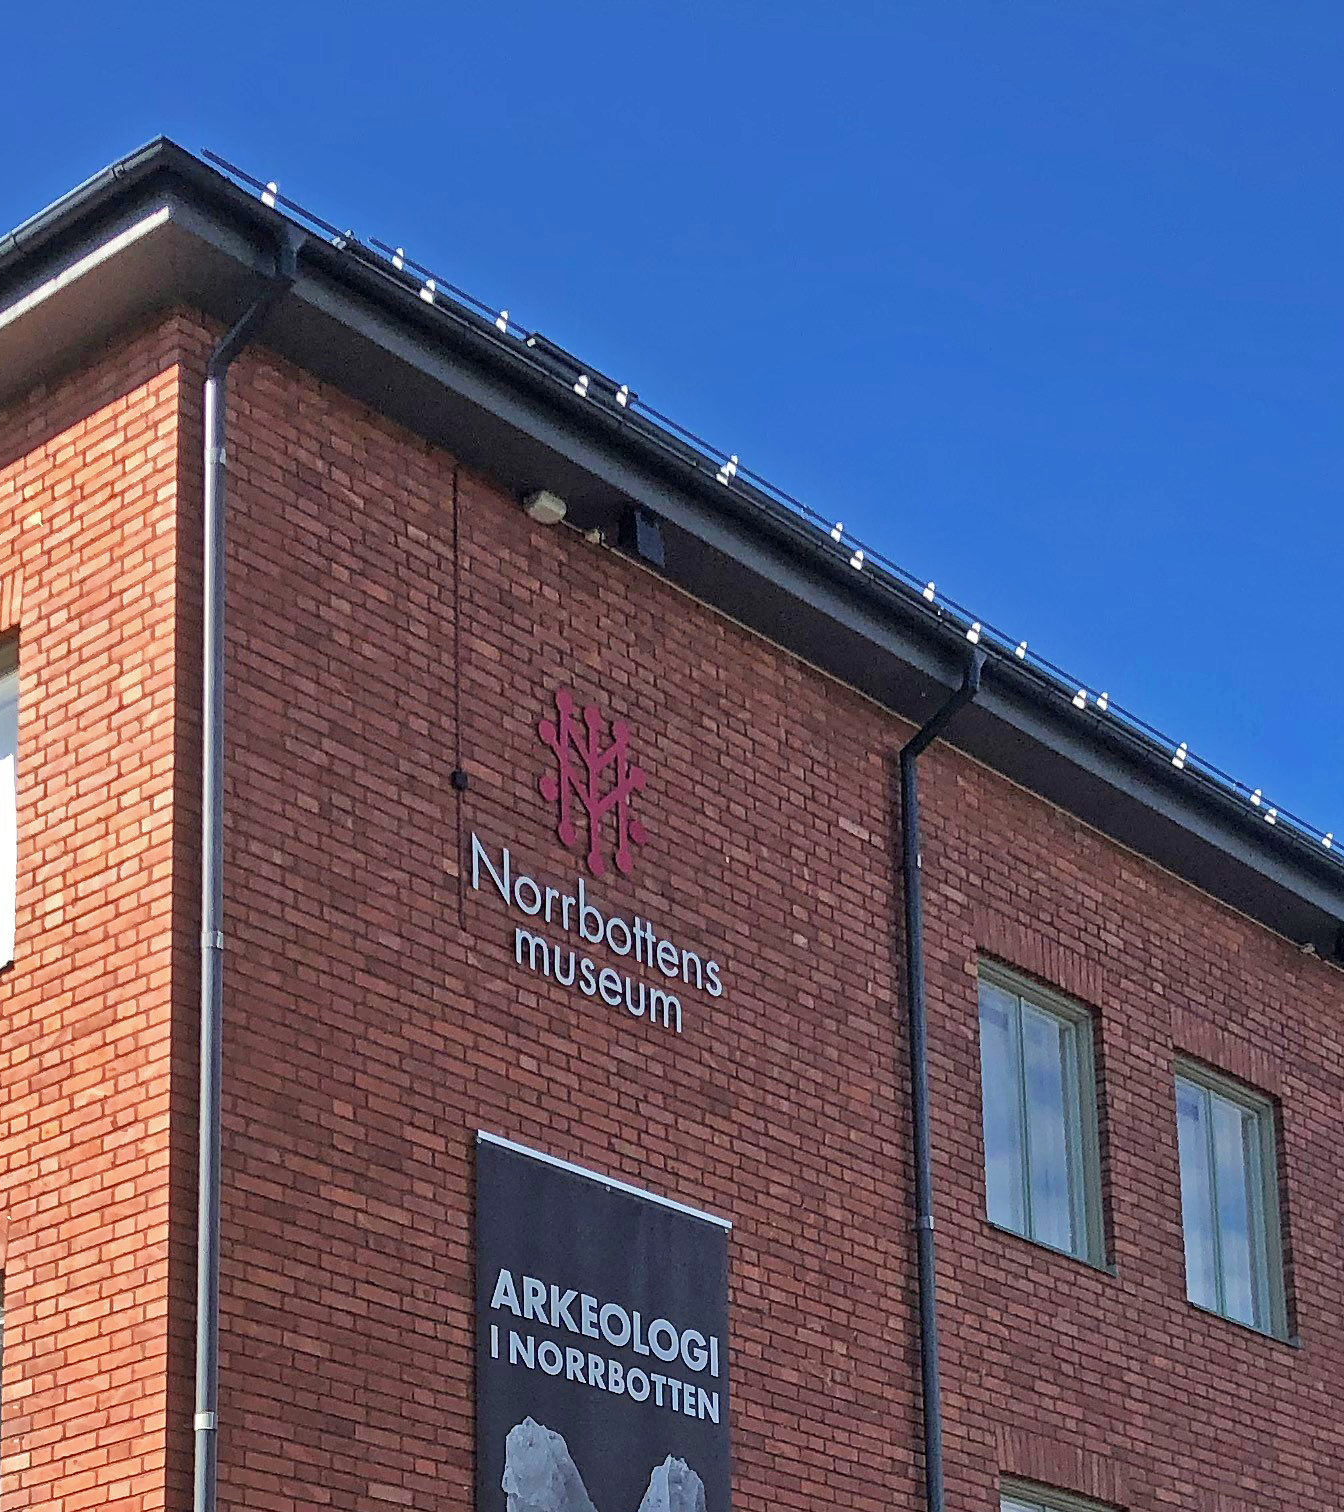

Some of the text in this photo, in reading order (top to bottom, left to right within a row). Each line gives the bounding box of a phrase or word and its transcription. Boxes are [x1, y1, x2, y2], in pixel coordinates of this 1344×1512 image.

[471, 831, 723, 997] Norrbottens
[515, 928, 683, 1033] museum
[490, 1268, 719, 1378] ARKEOLOGI
[490, 1324, 720, 1424] I NORRBOTTEN
